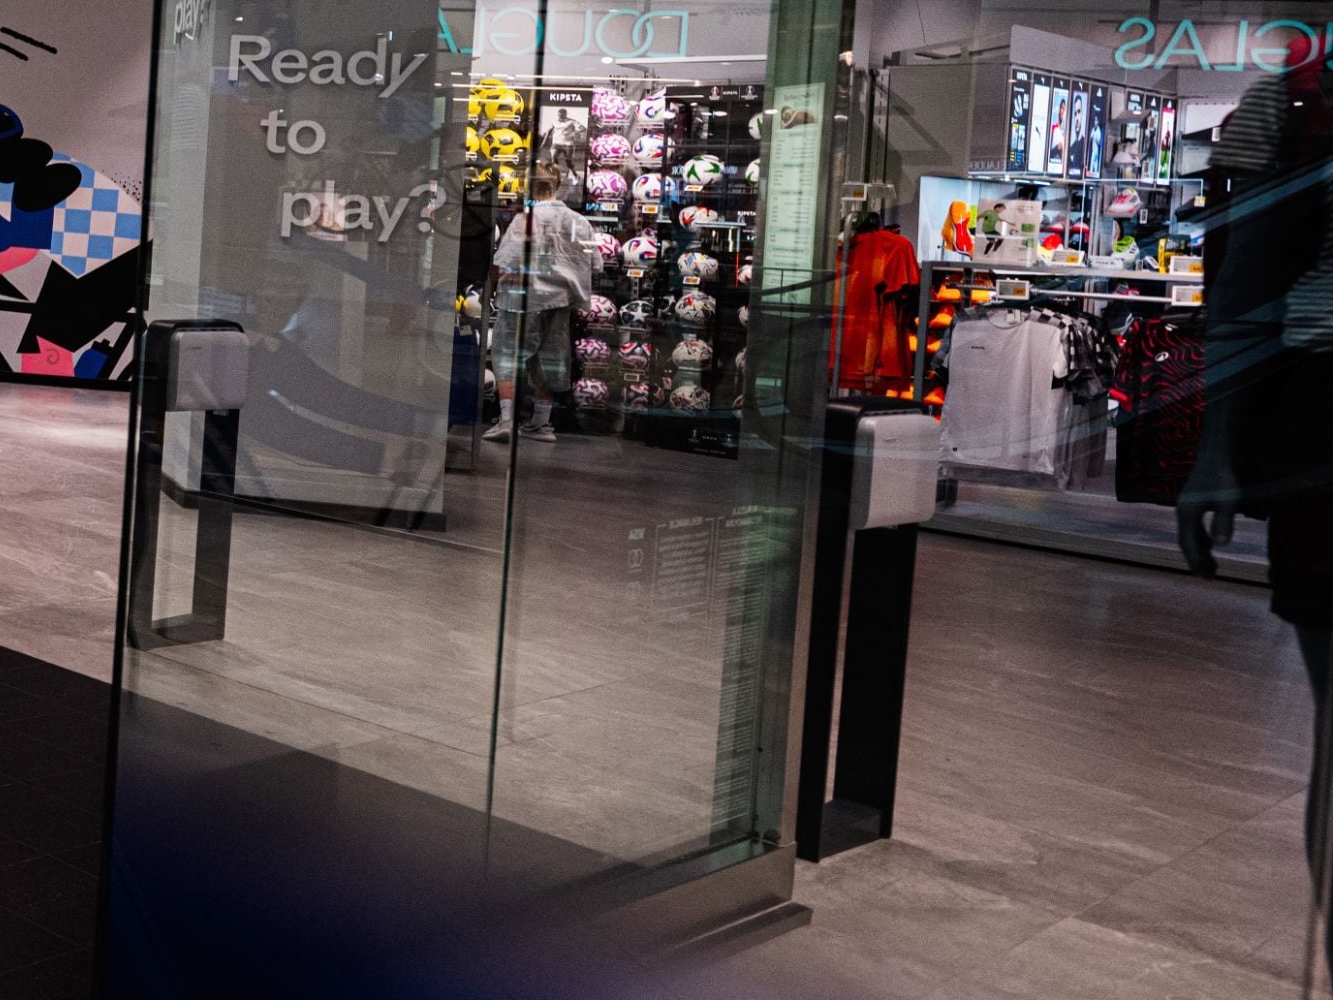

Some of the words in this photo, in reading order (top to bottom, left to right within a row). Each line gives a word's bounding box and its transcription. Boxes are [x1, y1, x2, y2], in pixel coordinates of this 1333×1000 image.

[228, 34, 430, 98] Ready
[549, 92, 582, 102] KIPSTA
[260, 110, 326, 155] to
[280, 180, 447, 242] play?
